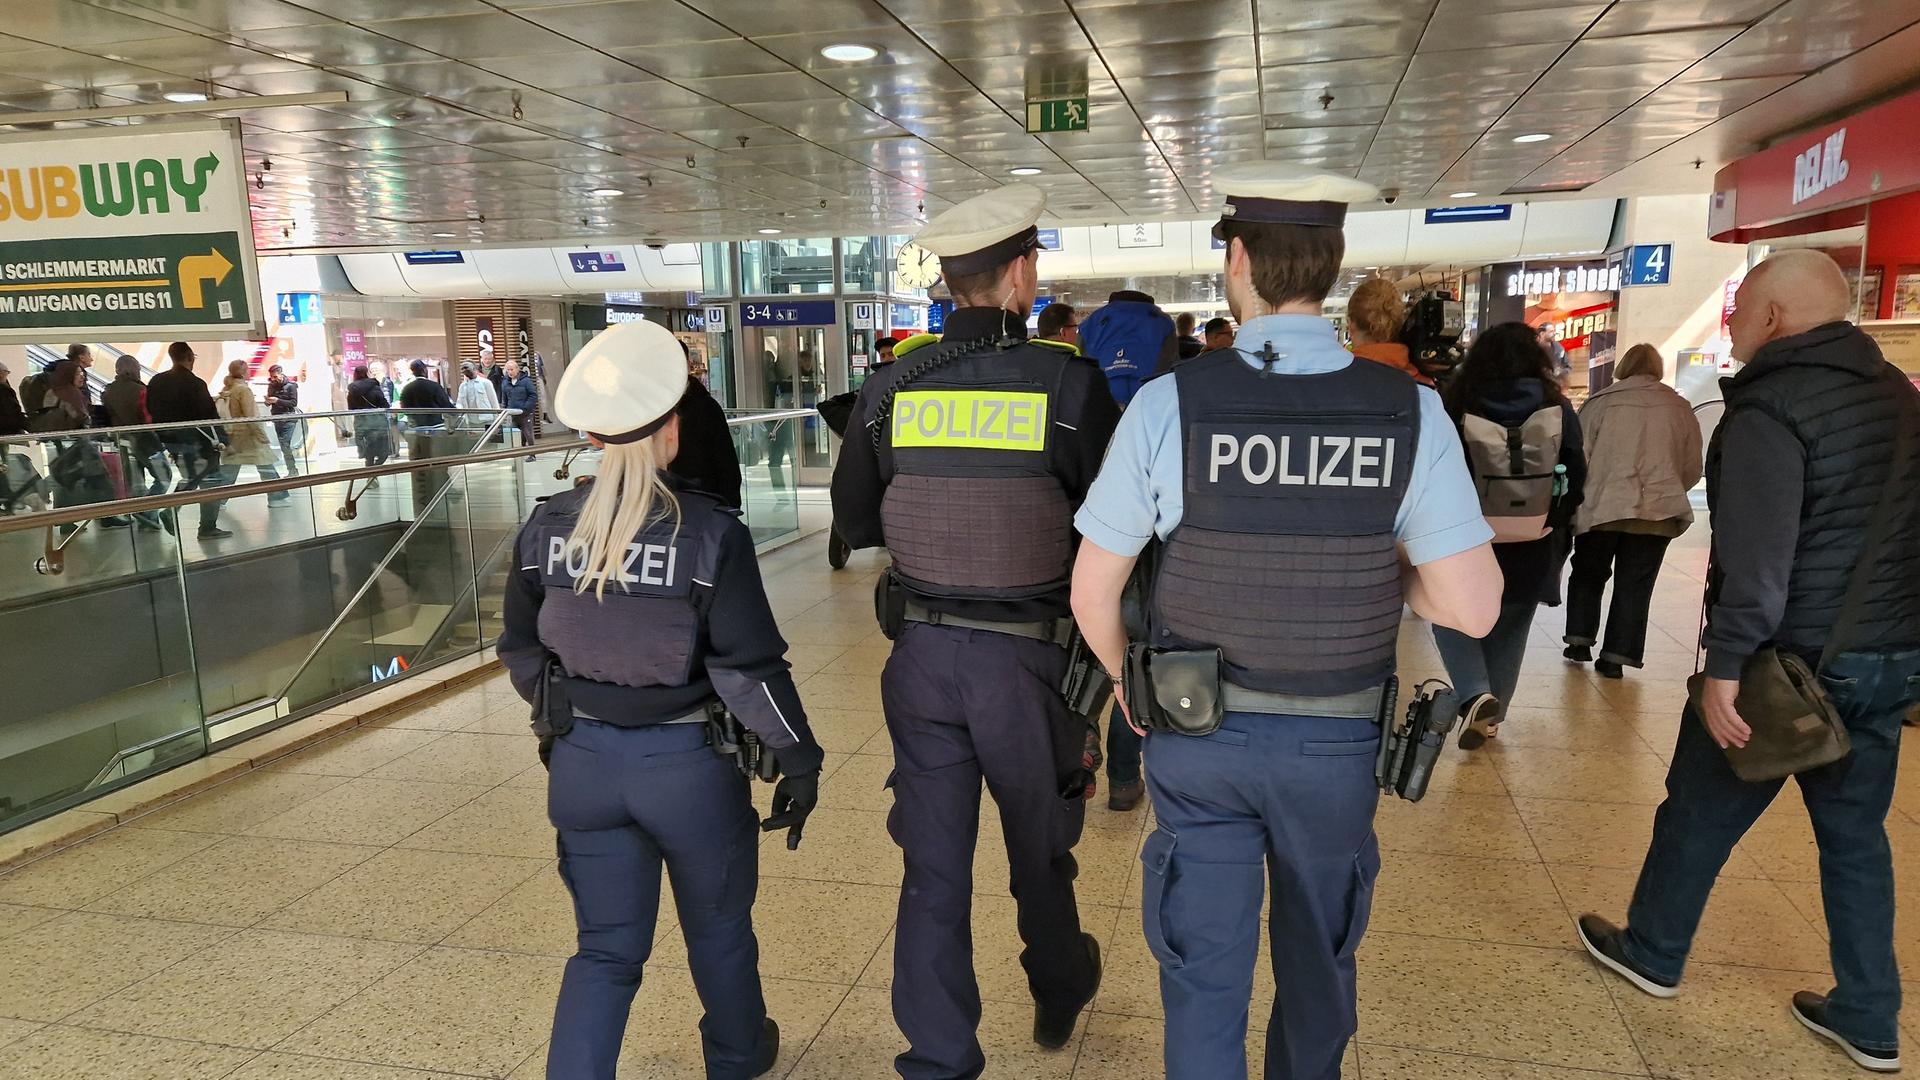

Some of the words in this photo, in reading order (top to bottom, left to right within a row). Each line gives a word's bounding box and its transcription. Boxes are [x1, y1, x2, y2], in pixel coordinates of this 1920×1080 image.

[5, 257, 167, 281] SCHLEMMERMARKT
[1645, 245, 1665, 273] 4
[1507, 267, 1561, 297] street
[1643, 273, 1660, 283] A-C
[16, 293, 103, 313] AUFGANG
[281, 293, 294, 315] 4
[746, 304, 771, 321] 3-4
[858, 305, 868, 318] U
[710, 310, 720, 322] U
[345, 351, 364, 360] 50%
[894, 399, 1044, 442] POLIZEI
[1209, 433, 1396, 488] POLIZEI
[546, 536, 677, 587] POZEI
